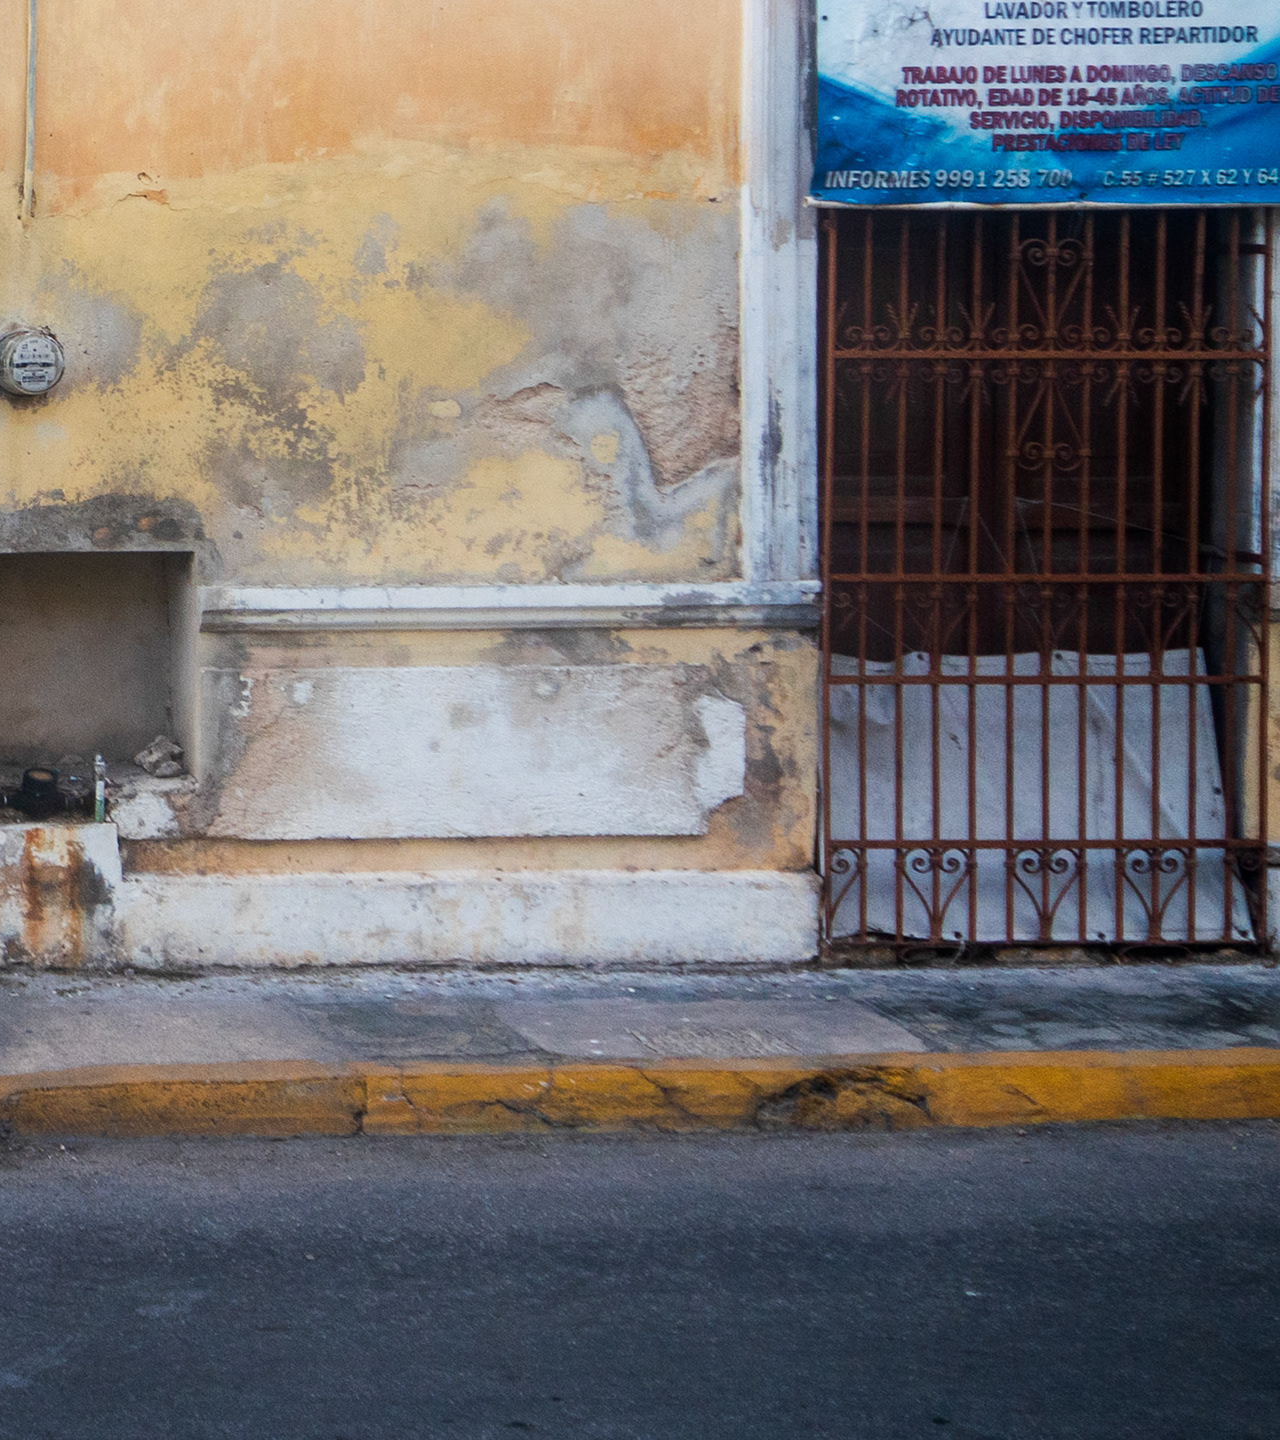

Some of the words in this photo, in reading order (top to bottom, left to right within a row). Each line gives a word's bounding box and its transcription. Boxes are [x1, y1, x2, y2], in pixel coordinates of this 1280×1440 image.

[984, 1, 1069, 20] LAVADOR
[1073, 1, 1084, 19] Y
[1087, 0, 1204, 19] TOMBOLERO
[930, 28, 1027, 47] AYUDANTE
[1032, 27, 1056, 46] DE
[1060, 27, 1134, 46] CHOFER
[1140, 25, 1259, 44] REPARTIDOR
[902, 66, 979, 84] TRABAJO
[983, 65, 1008, 83] DE
[1010, 65, 1067, 83] LUNES
[1069, 65, 1083, 83] A
[1180, 62, 1278, 82] DESCANSO
[896, 88, 984, 109] ROTATIVO,
[987, 88, 1035, 107] EDAD
[1037, 88, 1063, 106] DE
[969, 111, 1055, 132] SERVICIO,
[992, 133, 1123, 152] PRESTACIONES
[824, 170, 931, 189] INFORMES
[935, 169, 988, 188] 9991
[992, 169, 1031, 188] 258
[1162, 169, 1197, 187] 527
[1200, 169, 1212, 186] X
[1215, 169, 1239, 186] 62
[1241, 168, 1253, 185] Y
[1256, 168, 1279, 185] 64
